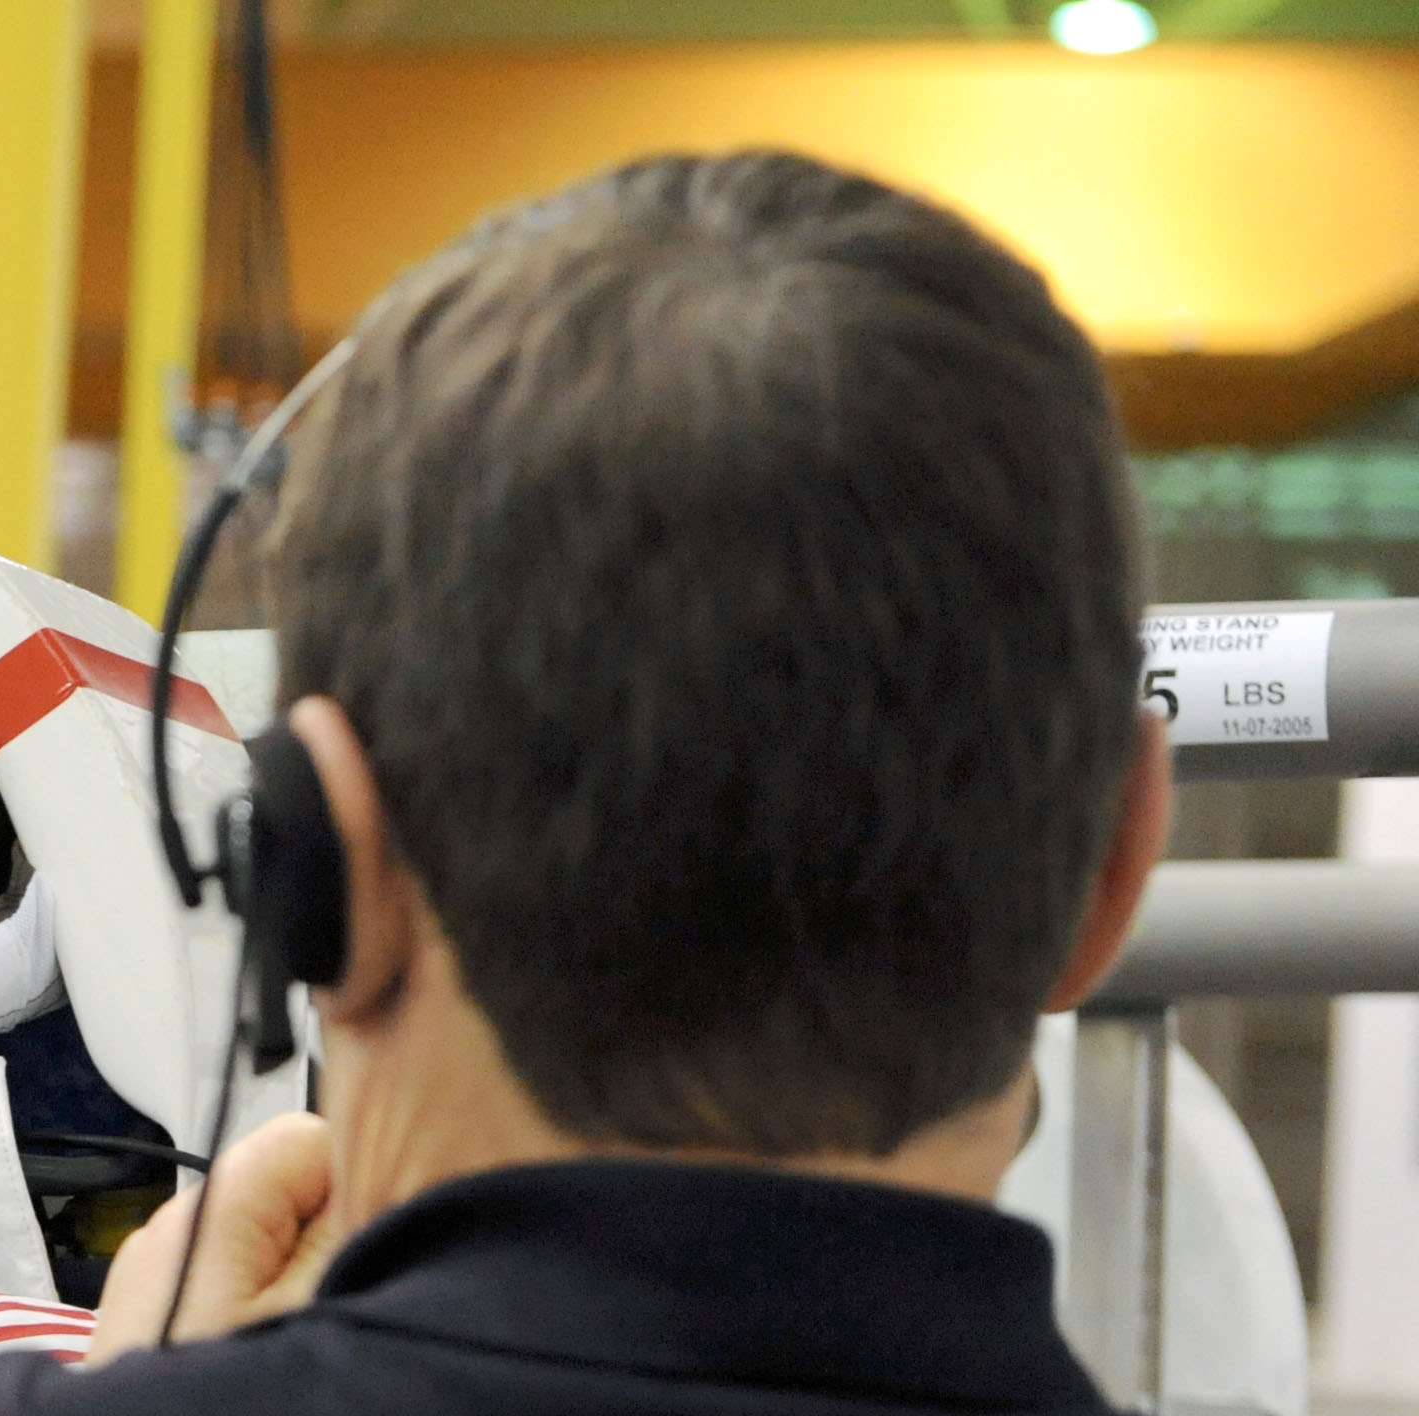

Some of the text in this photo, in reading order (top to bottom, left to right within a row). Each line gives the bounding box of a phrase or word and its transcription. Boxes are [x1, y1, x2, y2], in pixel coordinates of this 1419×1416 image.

[1141, 615, 1280, 633] ING STAND
[1170, 633, 1268, 652] WEIGHT
[1223, 682, 1286, 706] LBS
